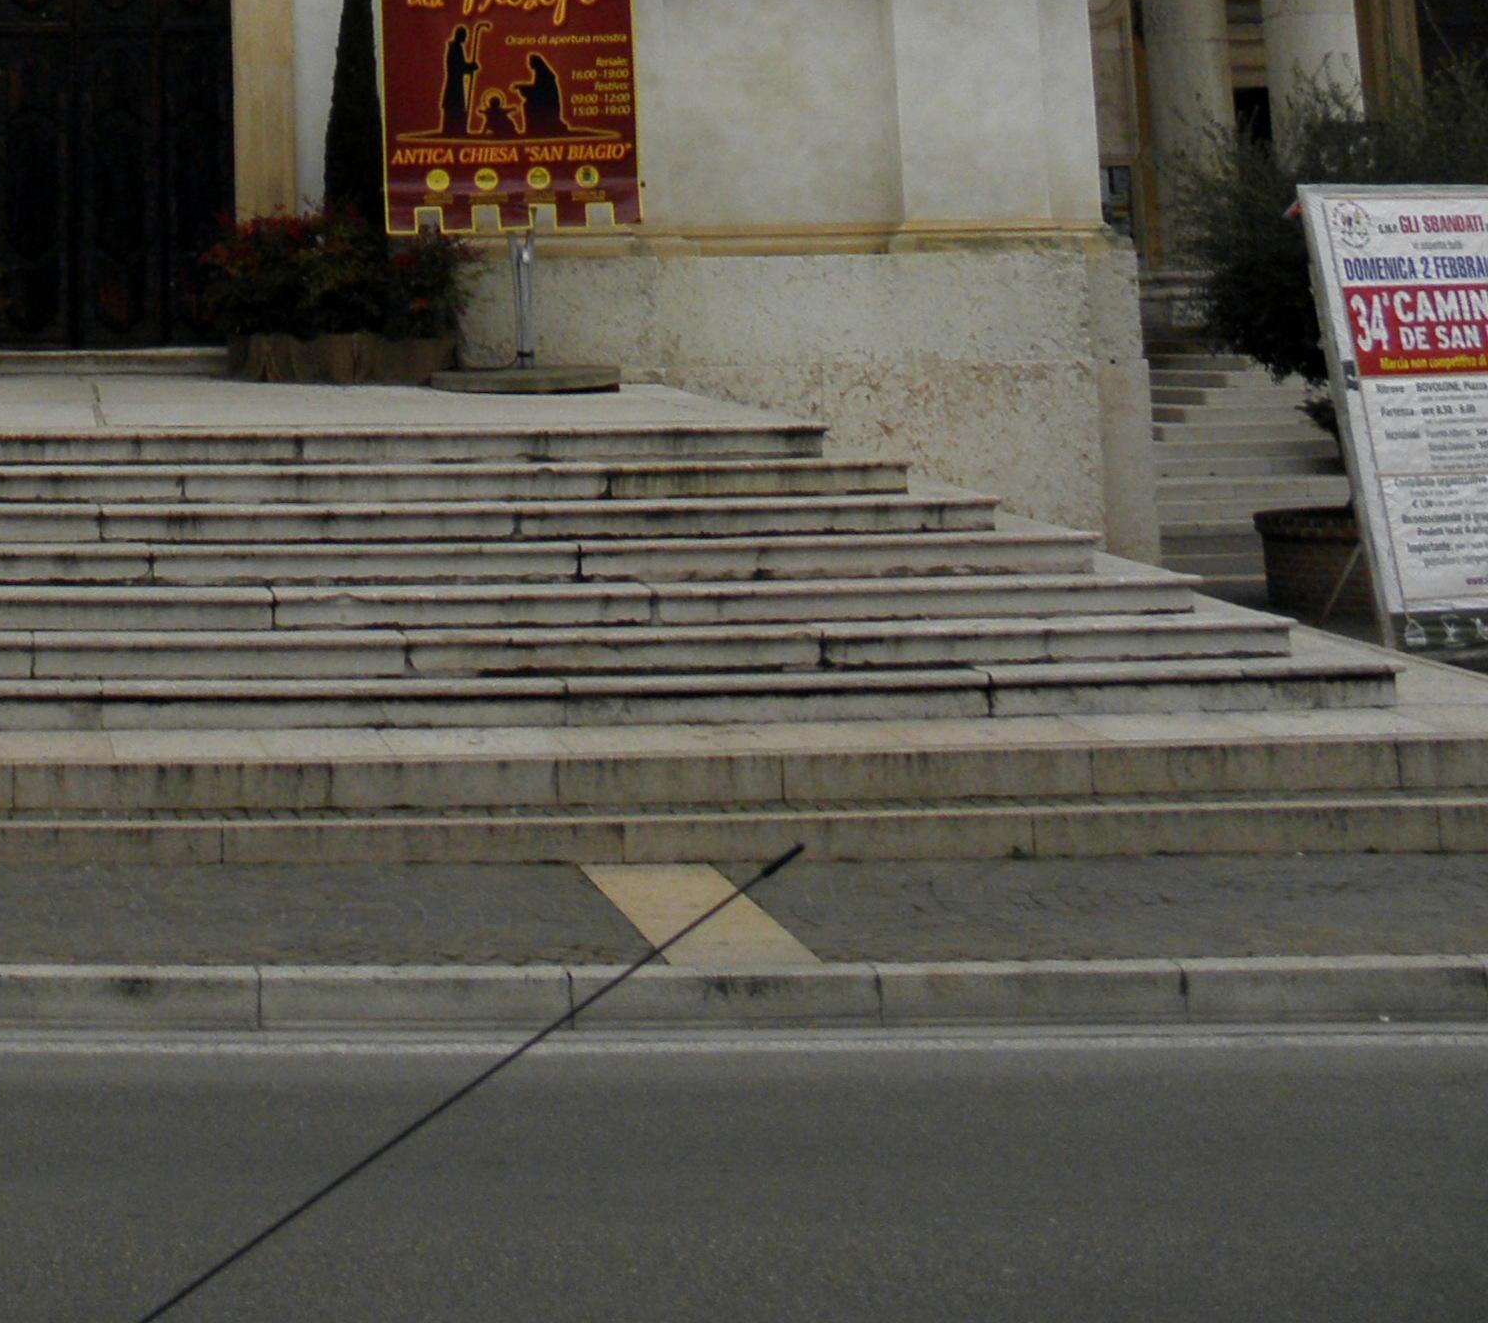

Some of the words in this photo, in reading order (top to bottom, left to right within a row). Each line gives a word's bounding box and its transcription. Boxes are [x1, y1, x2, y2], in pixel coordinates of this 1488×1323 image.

[505, 35, 536, 45] Orario
[537, 34, 547, 44] di
[549, 35, 591, 46] apertura
[592, 33, 627, 43] mostra
[392, 148, 455, 165] ANTICA
[459, 146, 519, 163] CHIESA
[524, 145, 563, 162] "SAN
[567, 143, 632, 161] BIAGIO"
[1398, 215, 1420, 234] GLI
[1421, 214, 1485, 233] SBANDATI
[1343, 256, 1417, 281] DOMENICA
[1420, 256, 1432, 279] 2
[1398, 325, 1431, 351] DE
[1435, 324, 1482, 349] SAN
[1380, 356, 1409, 370] Marcia
[1411, 358, 1428, 369] non
[1429, 355, 1477, 369] competitiva
